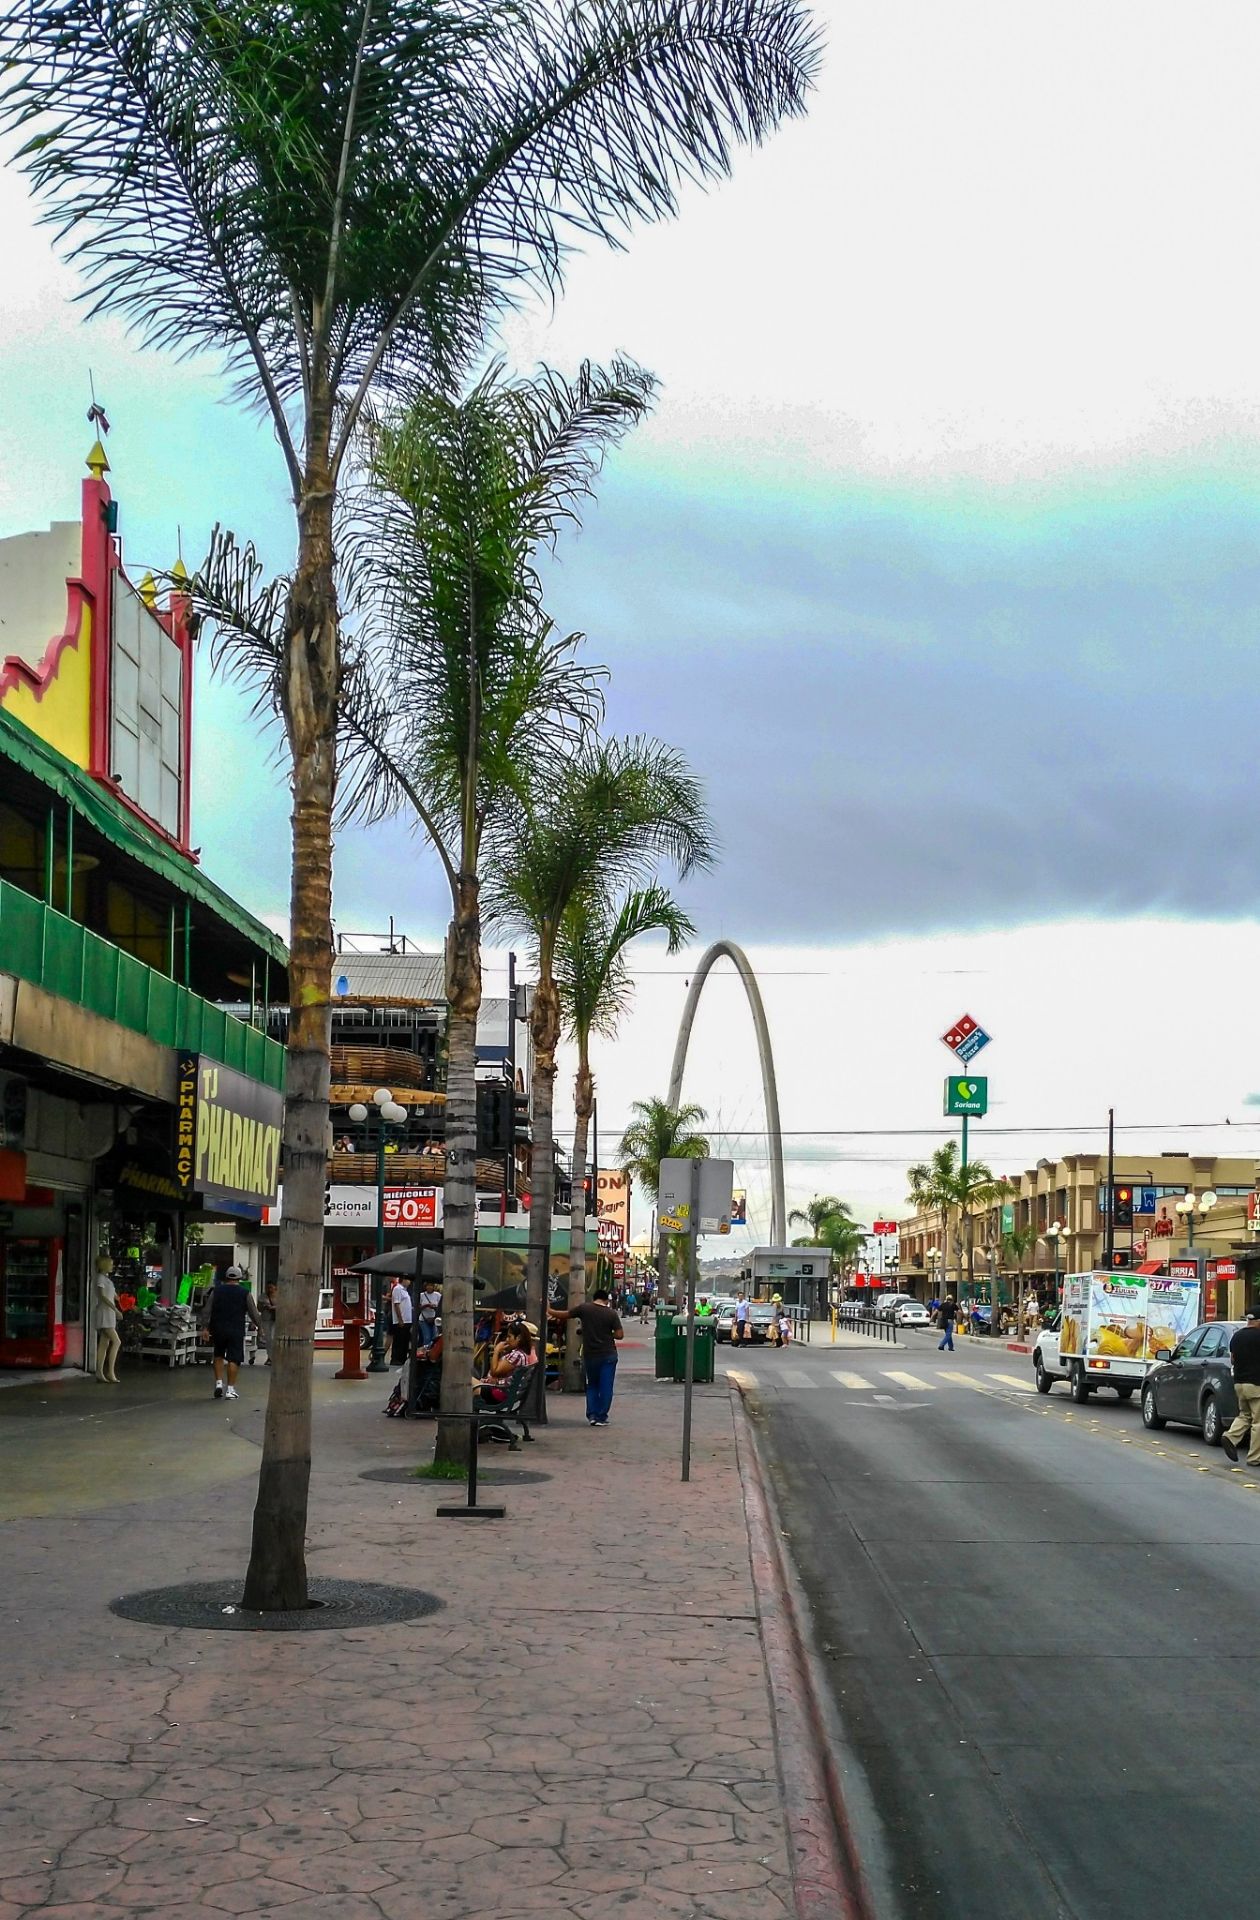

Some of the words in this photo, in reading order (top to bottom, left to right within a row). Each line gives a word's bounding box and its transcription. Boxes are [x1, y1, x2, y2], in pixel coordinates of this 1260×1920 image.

[957, 1031, 982, 1055] Domino's
[962, 1044, 979, 1060] Pizza
[202, 1068, 218, 1099] TJ
[954, 1101, 980, 1109] Soriana
[177, 1081, 194, 1187] PHARMACY
[195, 1099, 280, 1197] PHARMACY
